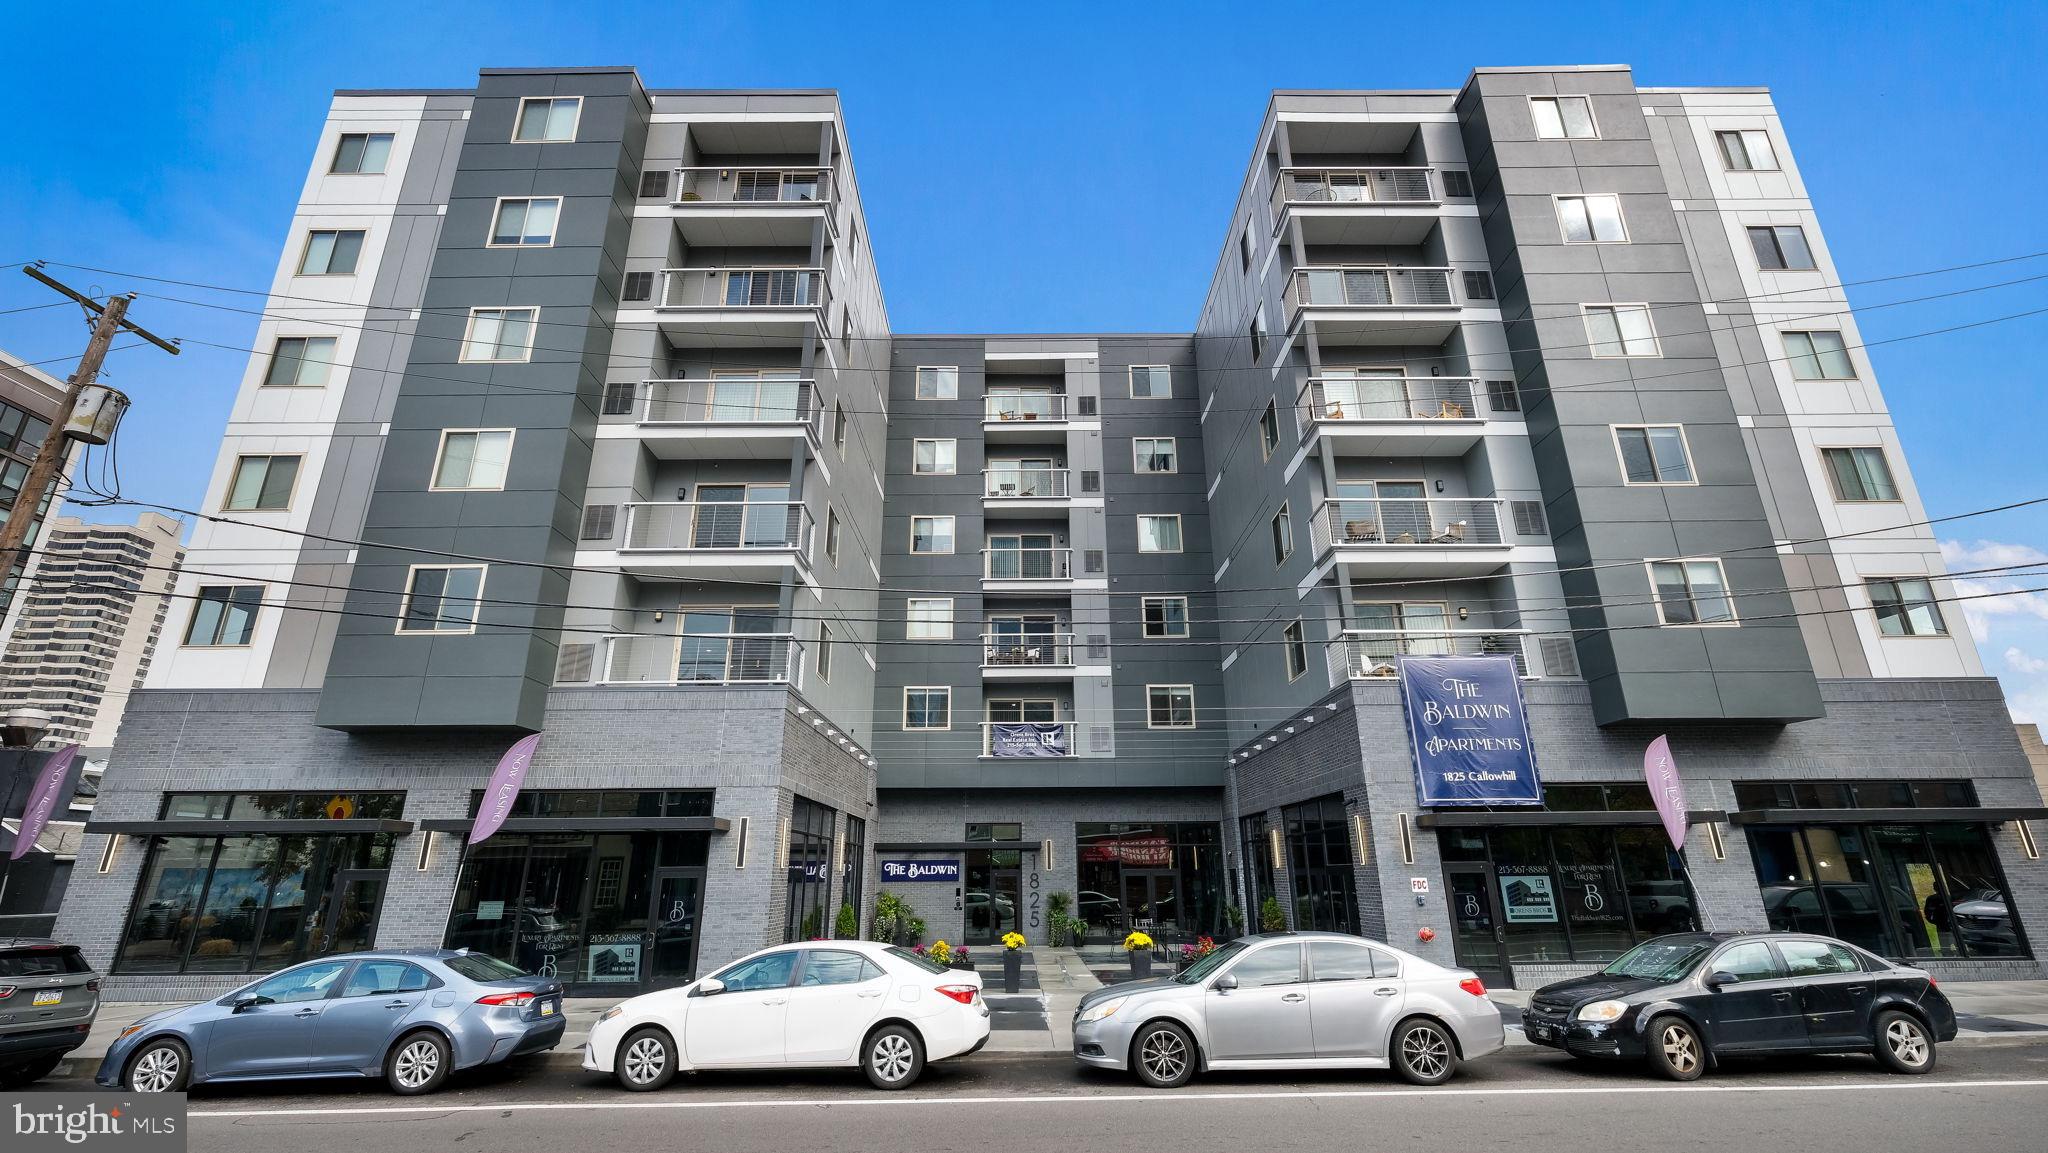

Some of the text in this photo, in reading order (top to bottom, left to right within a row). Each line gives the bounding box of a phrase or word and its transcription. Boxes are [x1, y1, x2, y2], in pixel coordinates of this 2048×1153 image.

[1442, 678, 1483, 699] THE
[1423, 701, 1511, 725] BALDWIN
[1425, 735, 1521, 757] APARTMENTS
[1442, 769, 1517, 782] 1825 Callowhill
[1655, 756, 1671, 780] NOW
[491, 753, 527, 823] NOW LEASING
[31, 763, 66, 838] NOW LEASING
[884, 862, 906, 877] THE
[907, 863, 958, 879] BALDWIN
[1498, 865, 1549, 874] 215-567-8888
[1029, 854, 1040, 928] 1825
[1412, 880, 1427, 890] FDC
[1584, 883, 1604, 912] B
[589, 934, 642, 944] 215-567-8888
